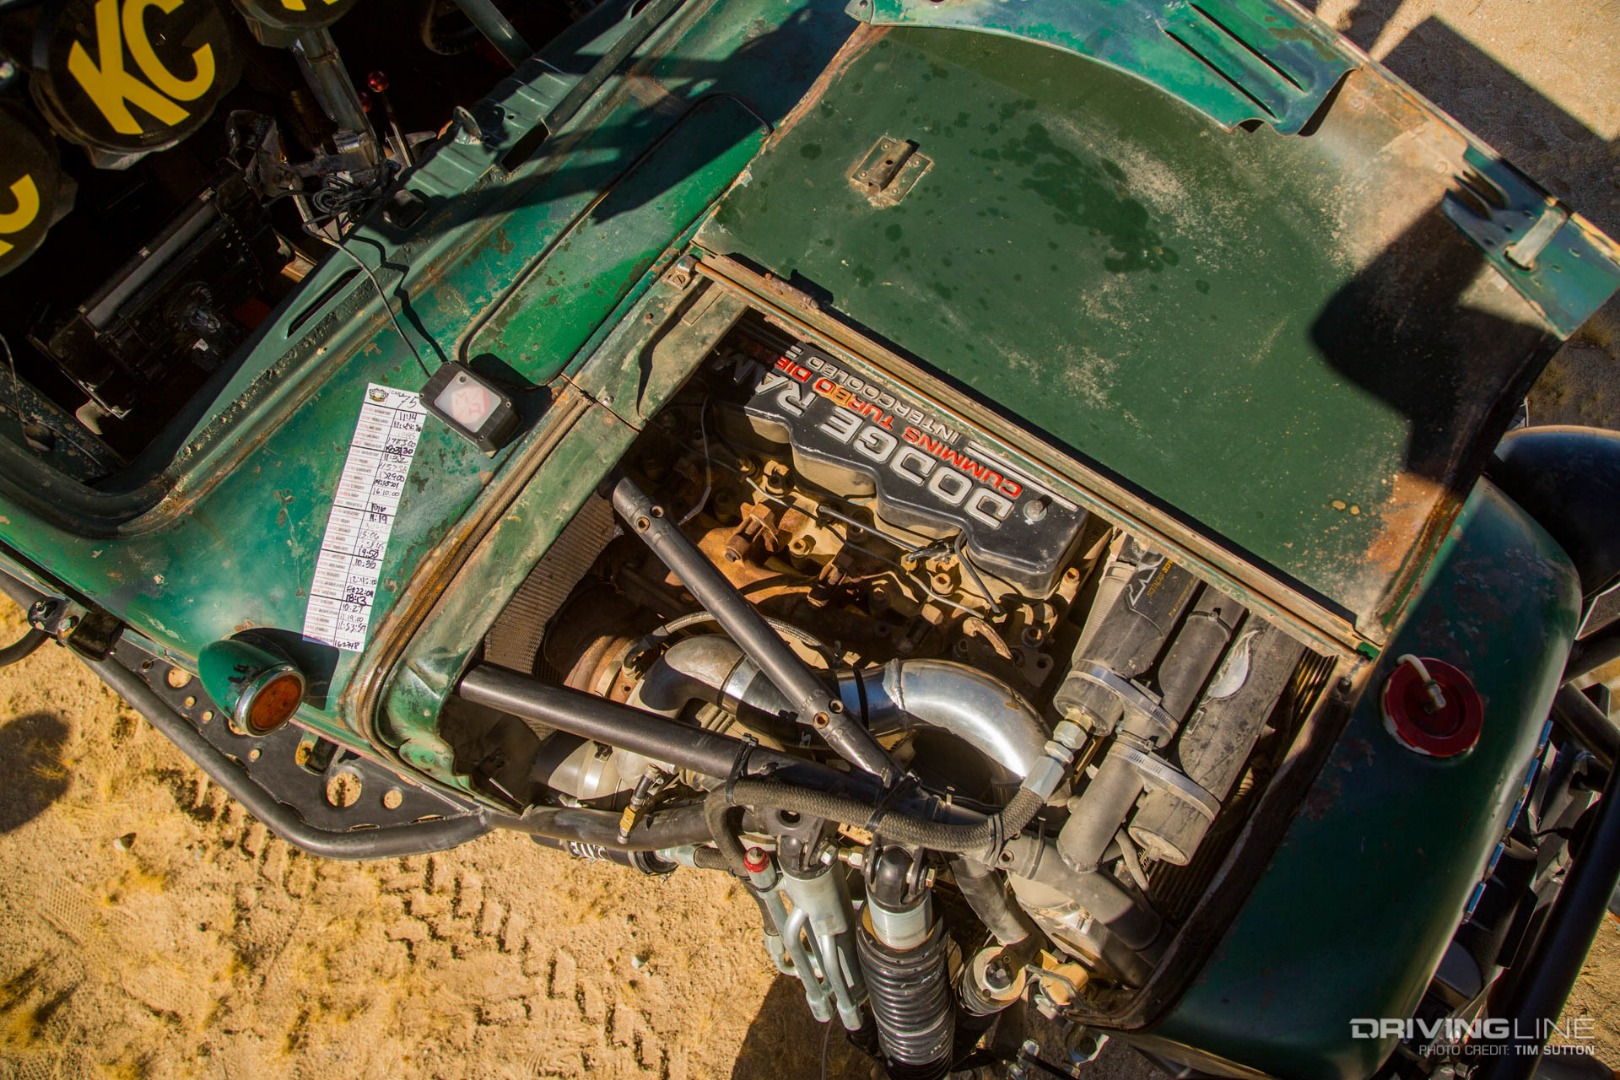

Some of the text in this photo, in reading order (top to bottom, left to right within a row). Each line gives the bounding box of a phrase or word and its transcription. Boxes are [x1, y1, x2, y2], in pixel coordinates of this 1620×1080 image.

[68, 0, 216, 134] KC
[710, 348, 1014, 530] DODGE RAM
[806, 355, 963, 446] INTERCOOLED
[815, 379, 896, 431] TURBO
[902, 427, 1023, 500] CUMMINS
